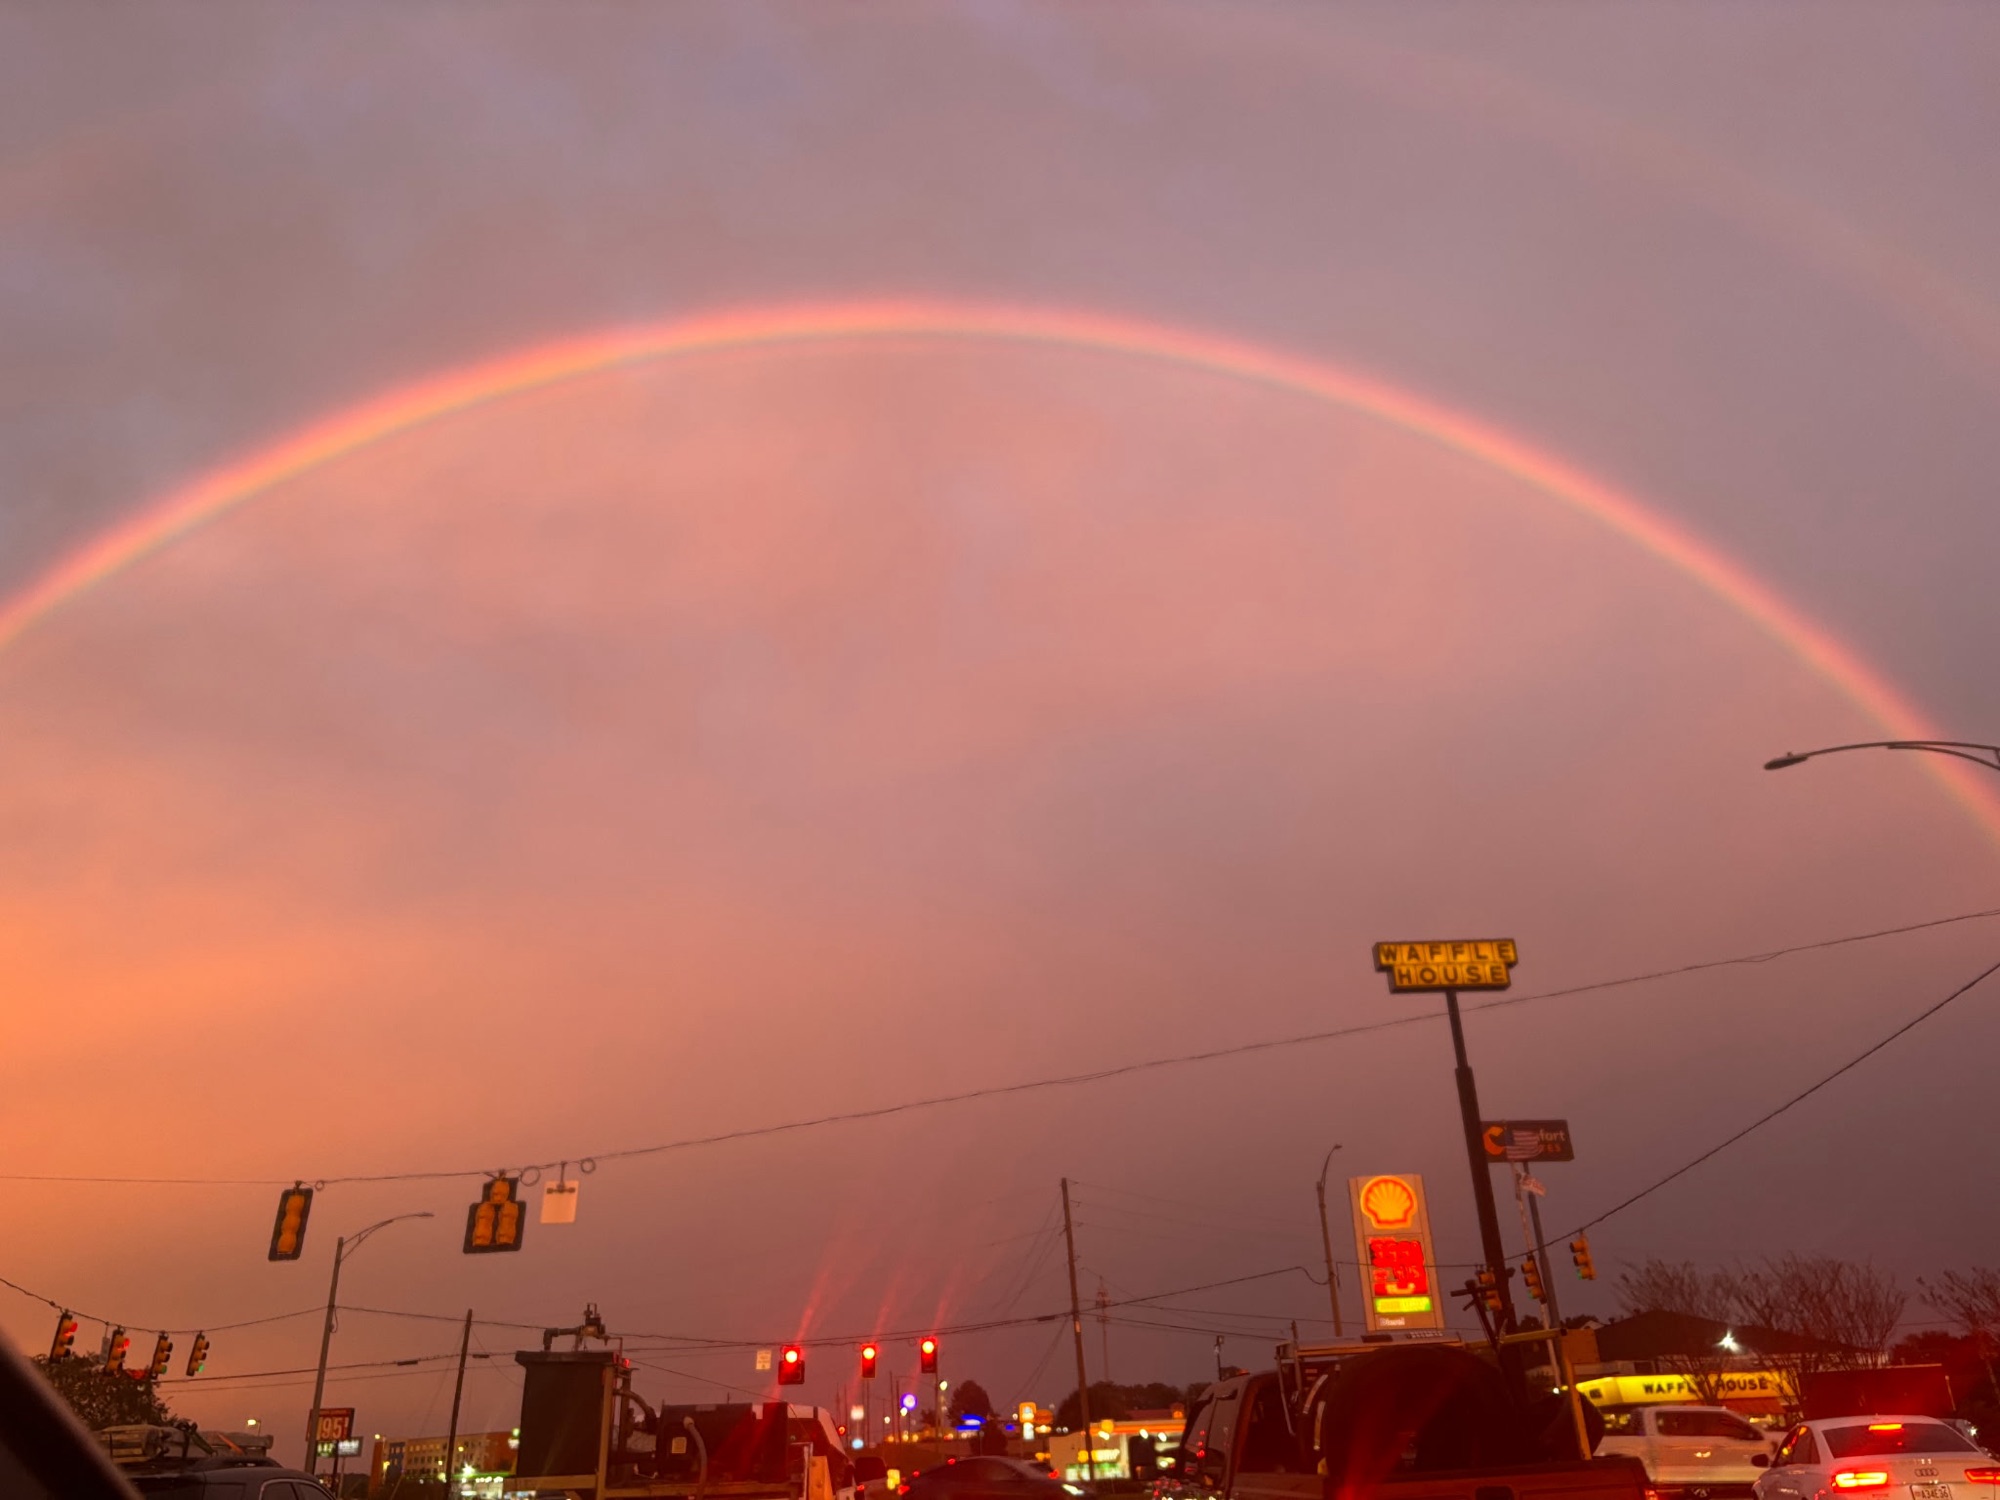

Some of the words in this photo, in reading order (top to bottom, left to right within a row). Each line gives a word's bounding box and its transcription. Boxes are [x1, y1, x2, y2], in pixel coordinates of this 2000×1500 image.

[1381, 942, 1512, 962] WAFFLE
[1398, 965, 1506, 984] HOUSE
[1715, 1377, 1769, 1392] HOUSE
